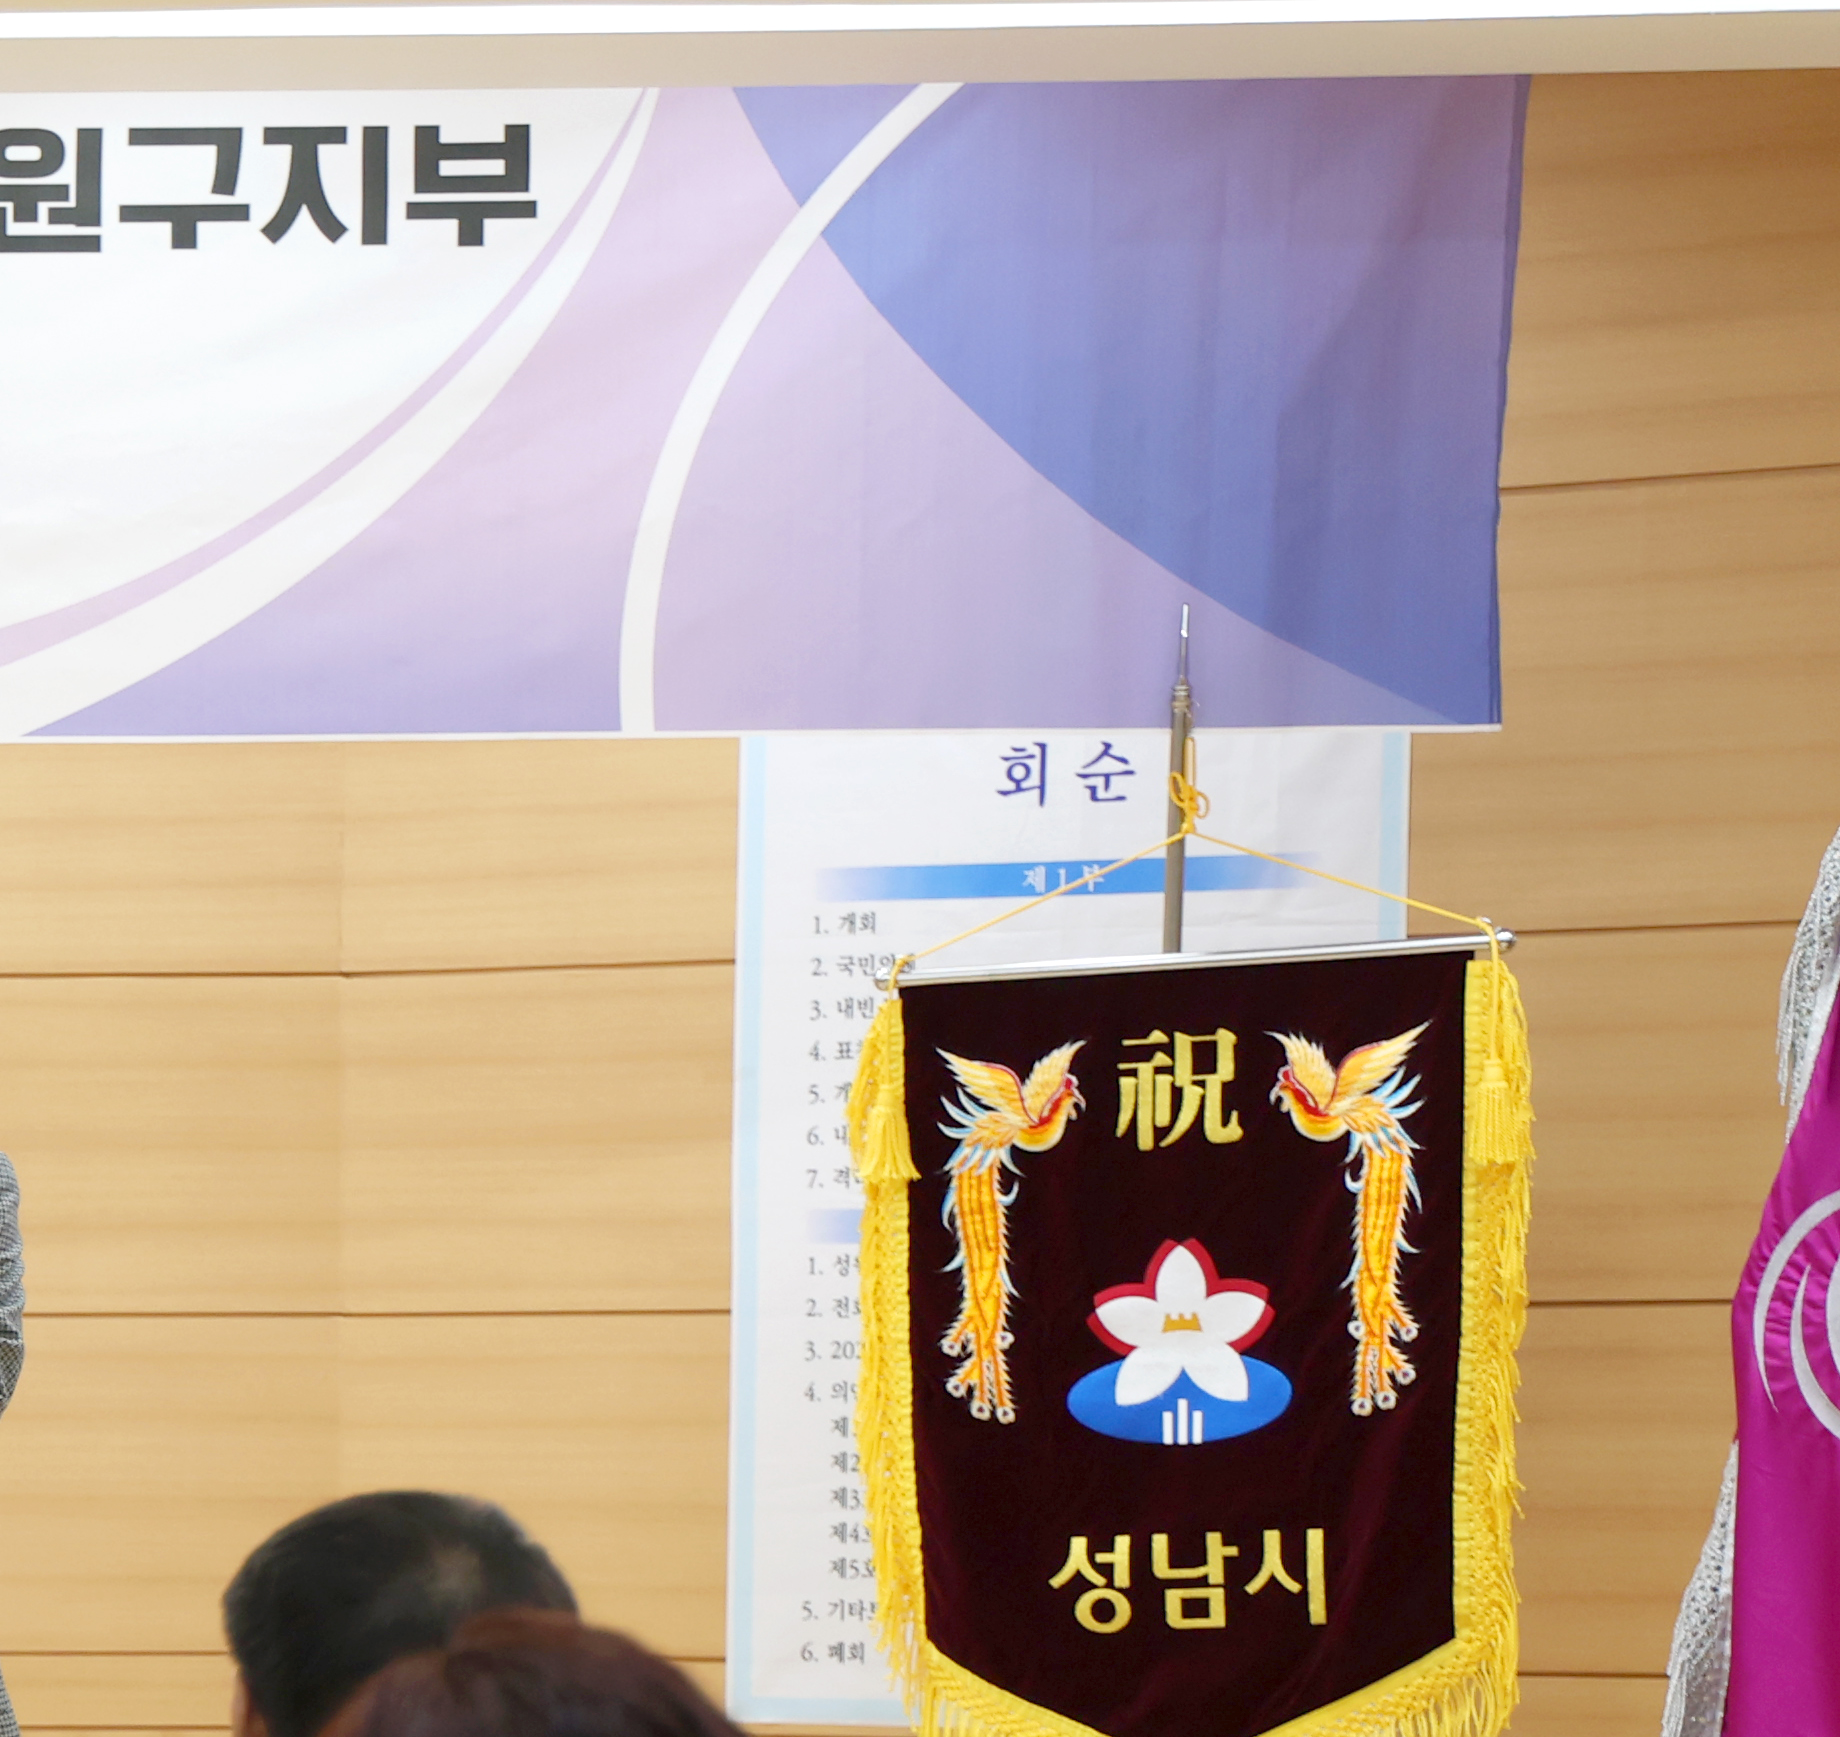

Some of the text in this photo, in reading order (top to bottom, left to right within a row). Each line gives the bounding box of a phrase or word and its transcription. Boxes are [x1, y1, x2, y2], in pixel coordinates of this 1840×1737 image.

[1115, 1026, 1245, 1152] 祝
[831, 1486, 865, 1511] 제3
[1048, 1526, 1328, 1635] 성남시
